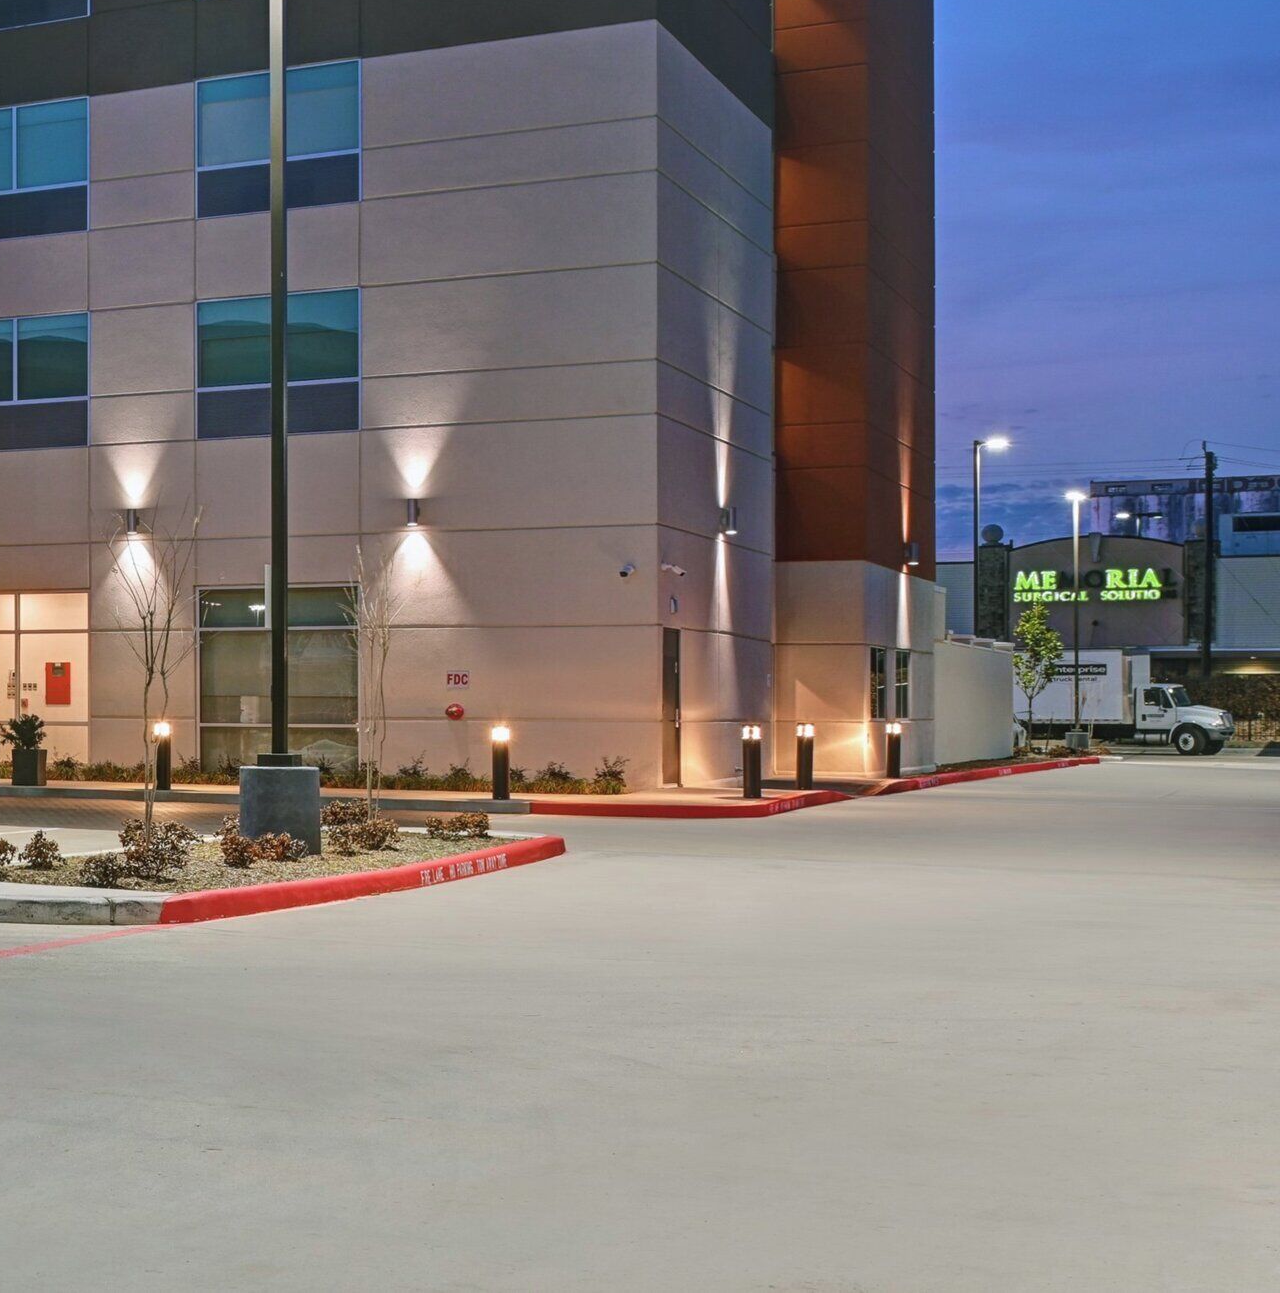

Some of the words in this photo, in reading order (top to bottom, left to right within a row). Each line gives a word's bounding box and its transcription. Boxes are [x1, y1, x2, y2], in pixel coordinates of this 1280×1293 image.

[1100, 589, 1162, 602] SOLUTIO
[1056, 665, 1106, 674] nteprise
[446, 673, 468, 685] FDC
